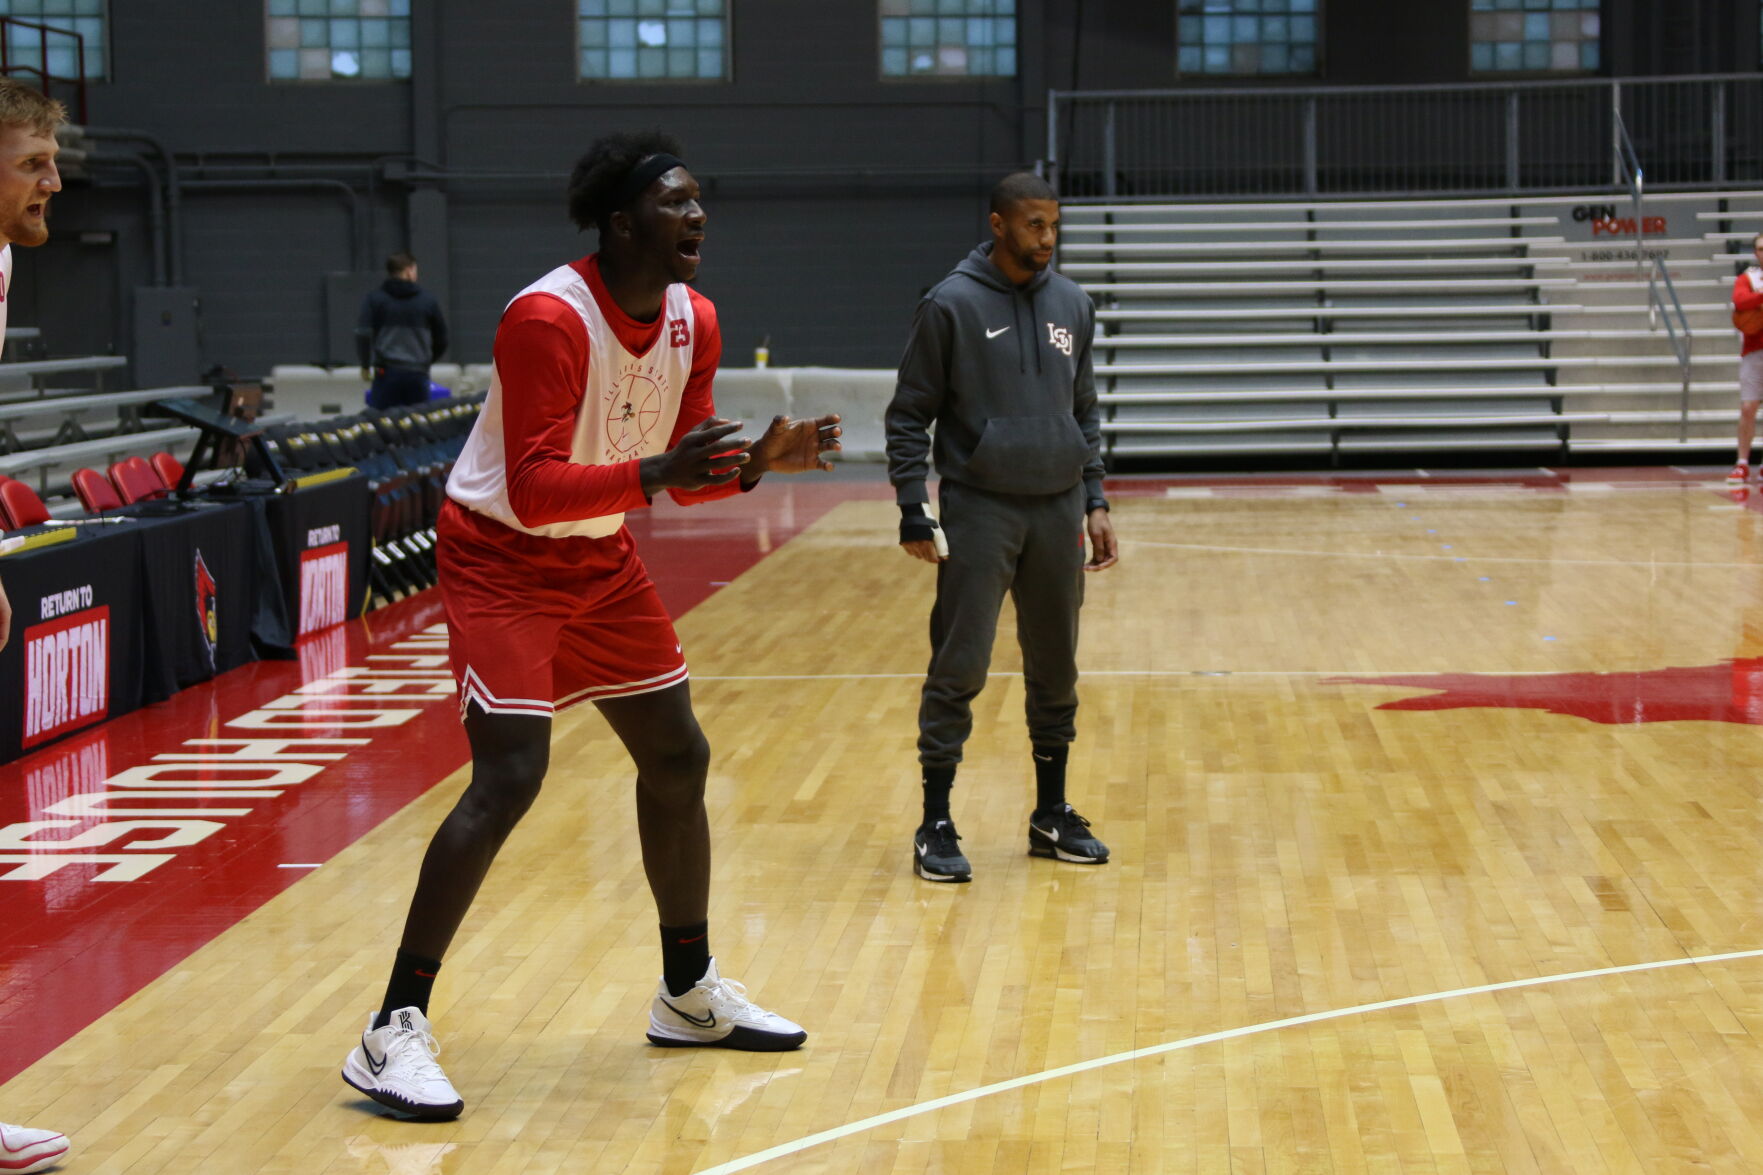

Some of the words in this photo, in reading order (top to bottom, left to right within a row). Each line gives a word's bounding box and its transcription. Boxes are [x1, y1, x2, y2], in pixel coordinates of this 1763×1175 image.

[1572, 204, 1616, 223] GEN
[1592, 215, 1667, 237] POWER
[670, 318, 690, 348] 23
[41, 588, 80, 619] RETURN
[79, 584, 93, 608] TO
[26, 618, 106, 738] HORTON
